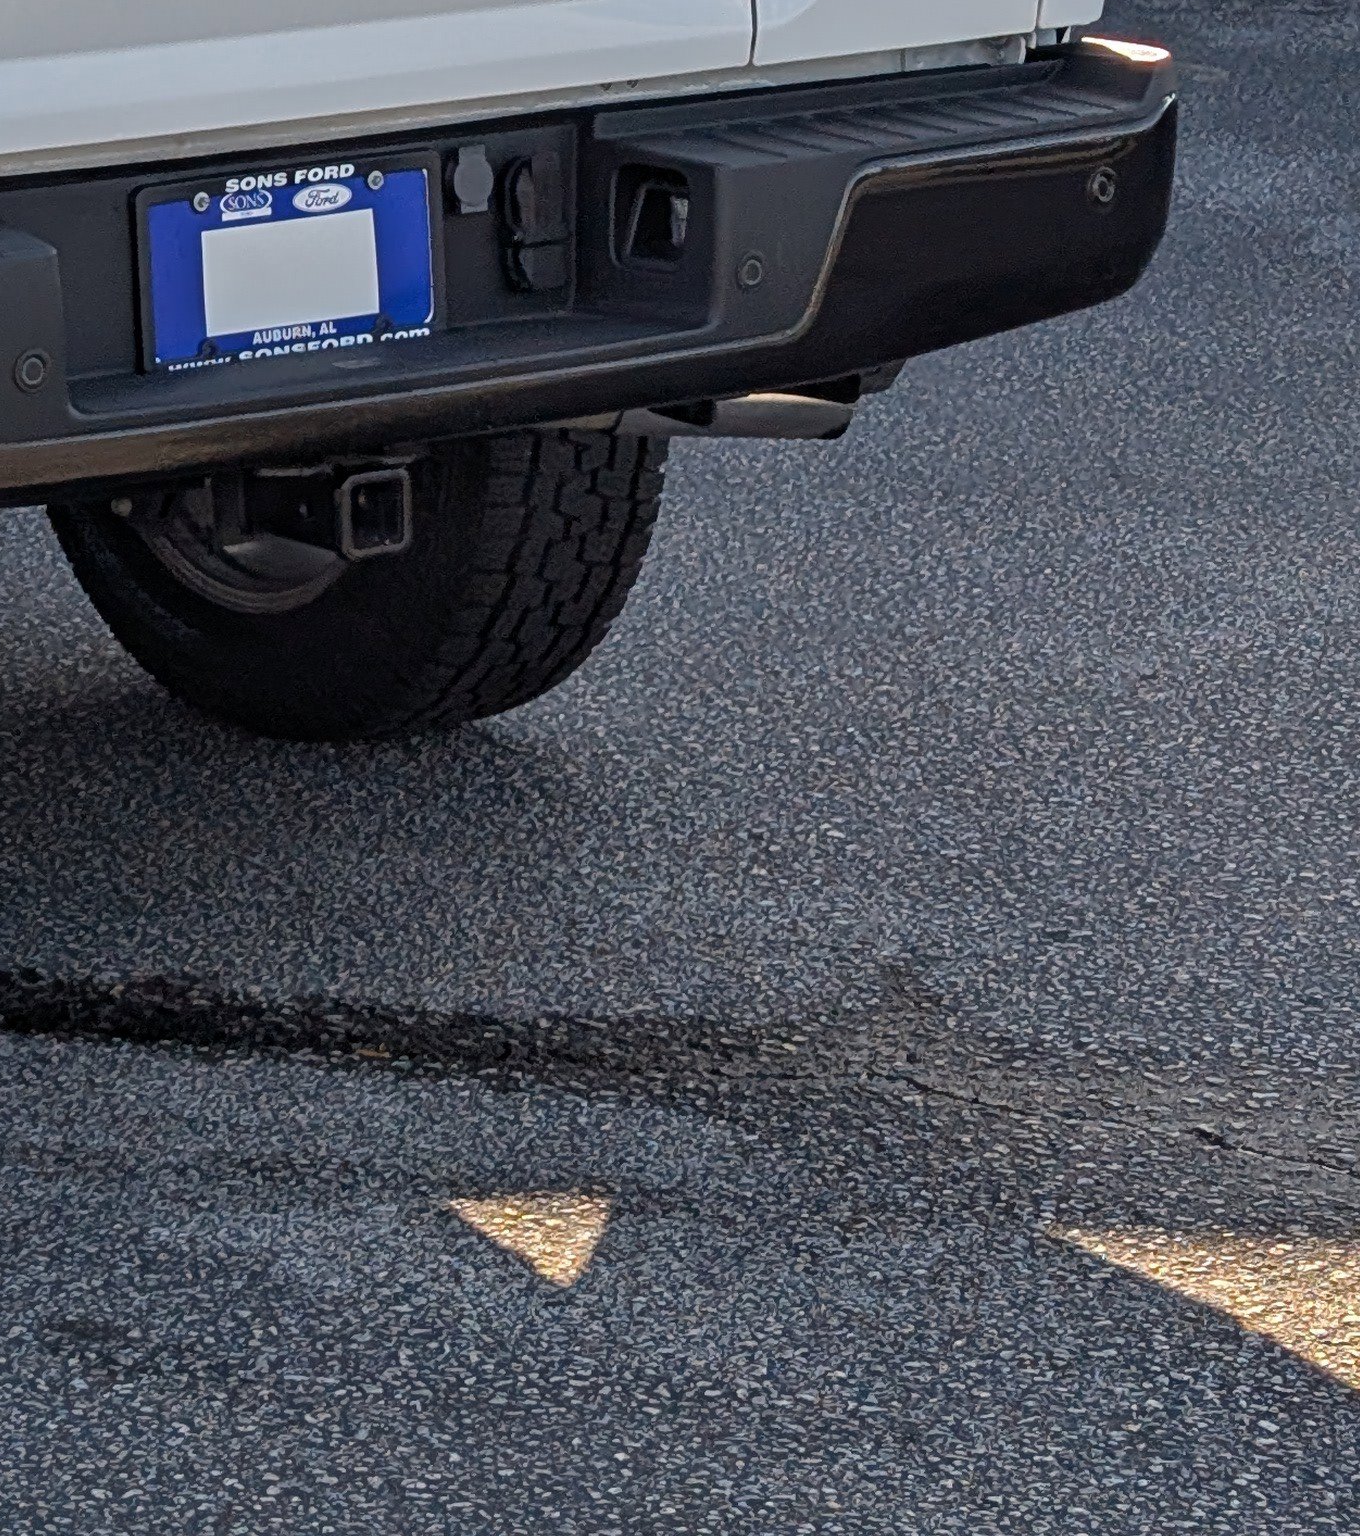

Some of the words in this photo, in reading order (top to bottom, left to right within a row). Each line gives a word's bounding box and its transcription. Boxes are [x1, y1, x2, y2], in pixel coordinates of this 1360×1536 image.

[225, 172, 288, 193] SONS
[294, 164, 355, 184] FORD
[228, 193, 265, 211] SONS
[305, 188, 340, 208] Ford
[253, 325, 316, 345] AUBURN,
[320, 321, 337, 335] AL
